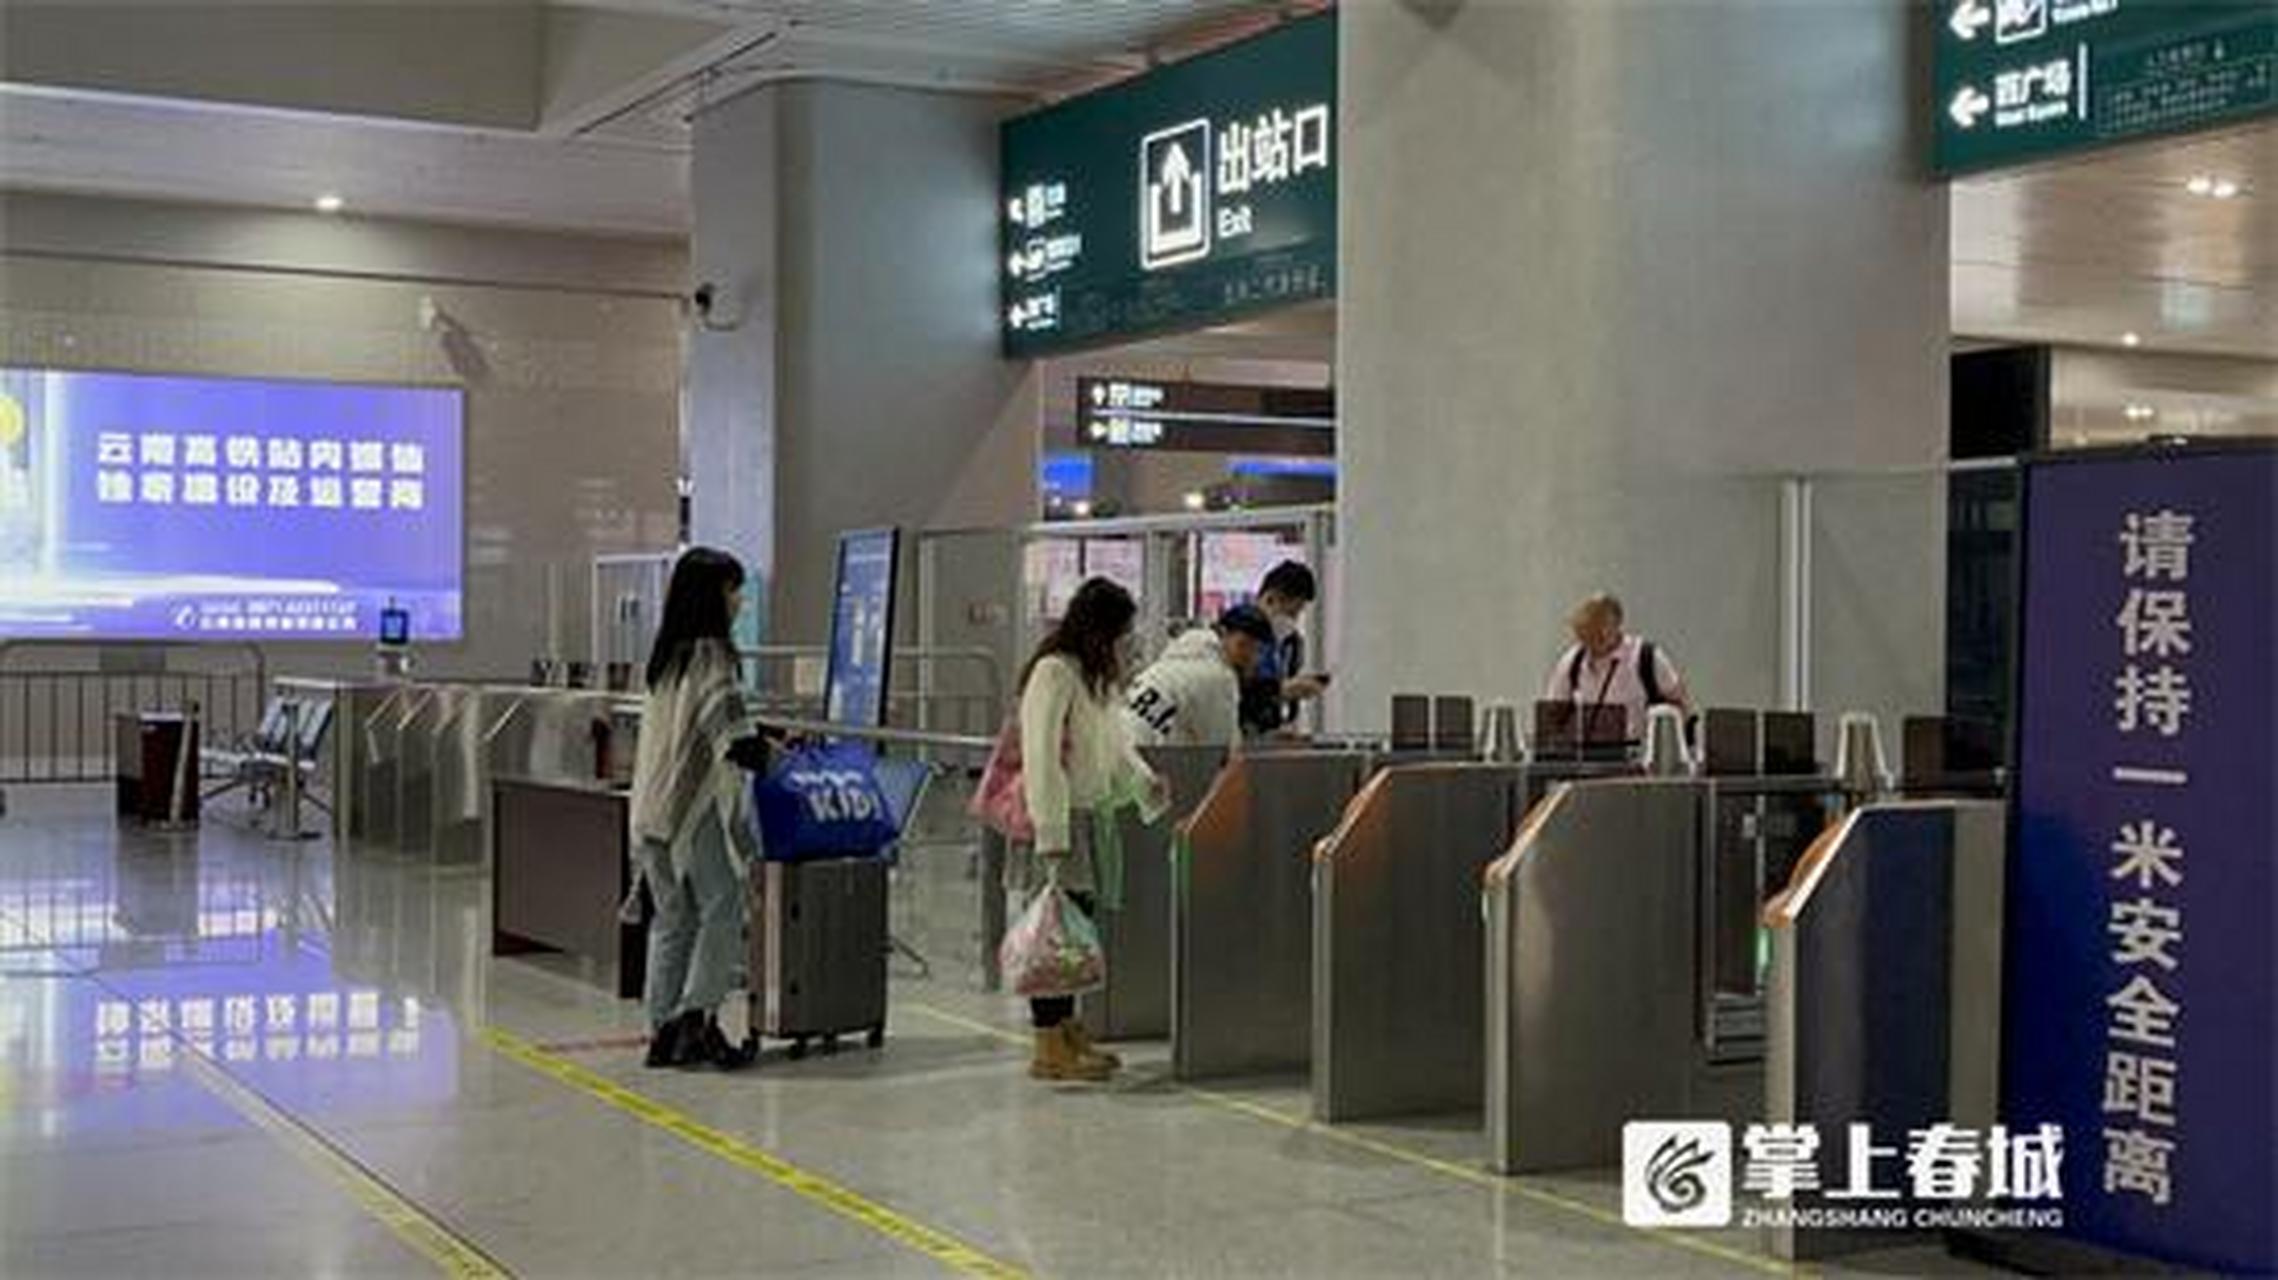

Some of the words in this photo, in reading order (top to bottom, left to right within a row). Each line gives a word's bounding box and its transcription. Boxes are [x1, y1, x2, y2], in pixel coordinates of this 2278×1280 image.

[1216, 104, 1329, 195] 出站口
[1217, 204, 1252, 238] Exit
[2102, 511, 2194, 1205] 请保持一米安全距离
